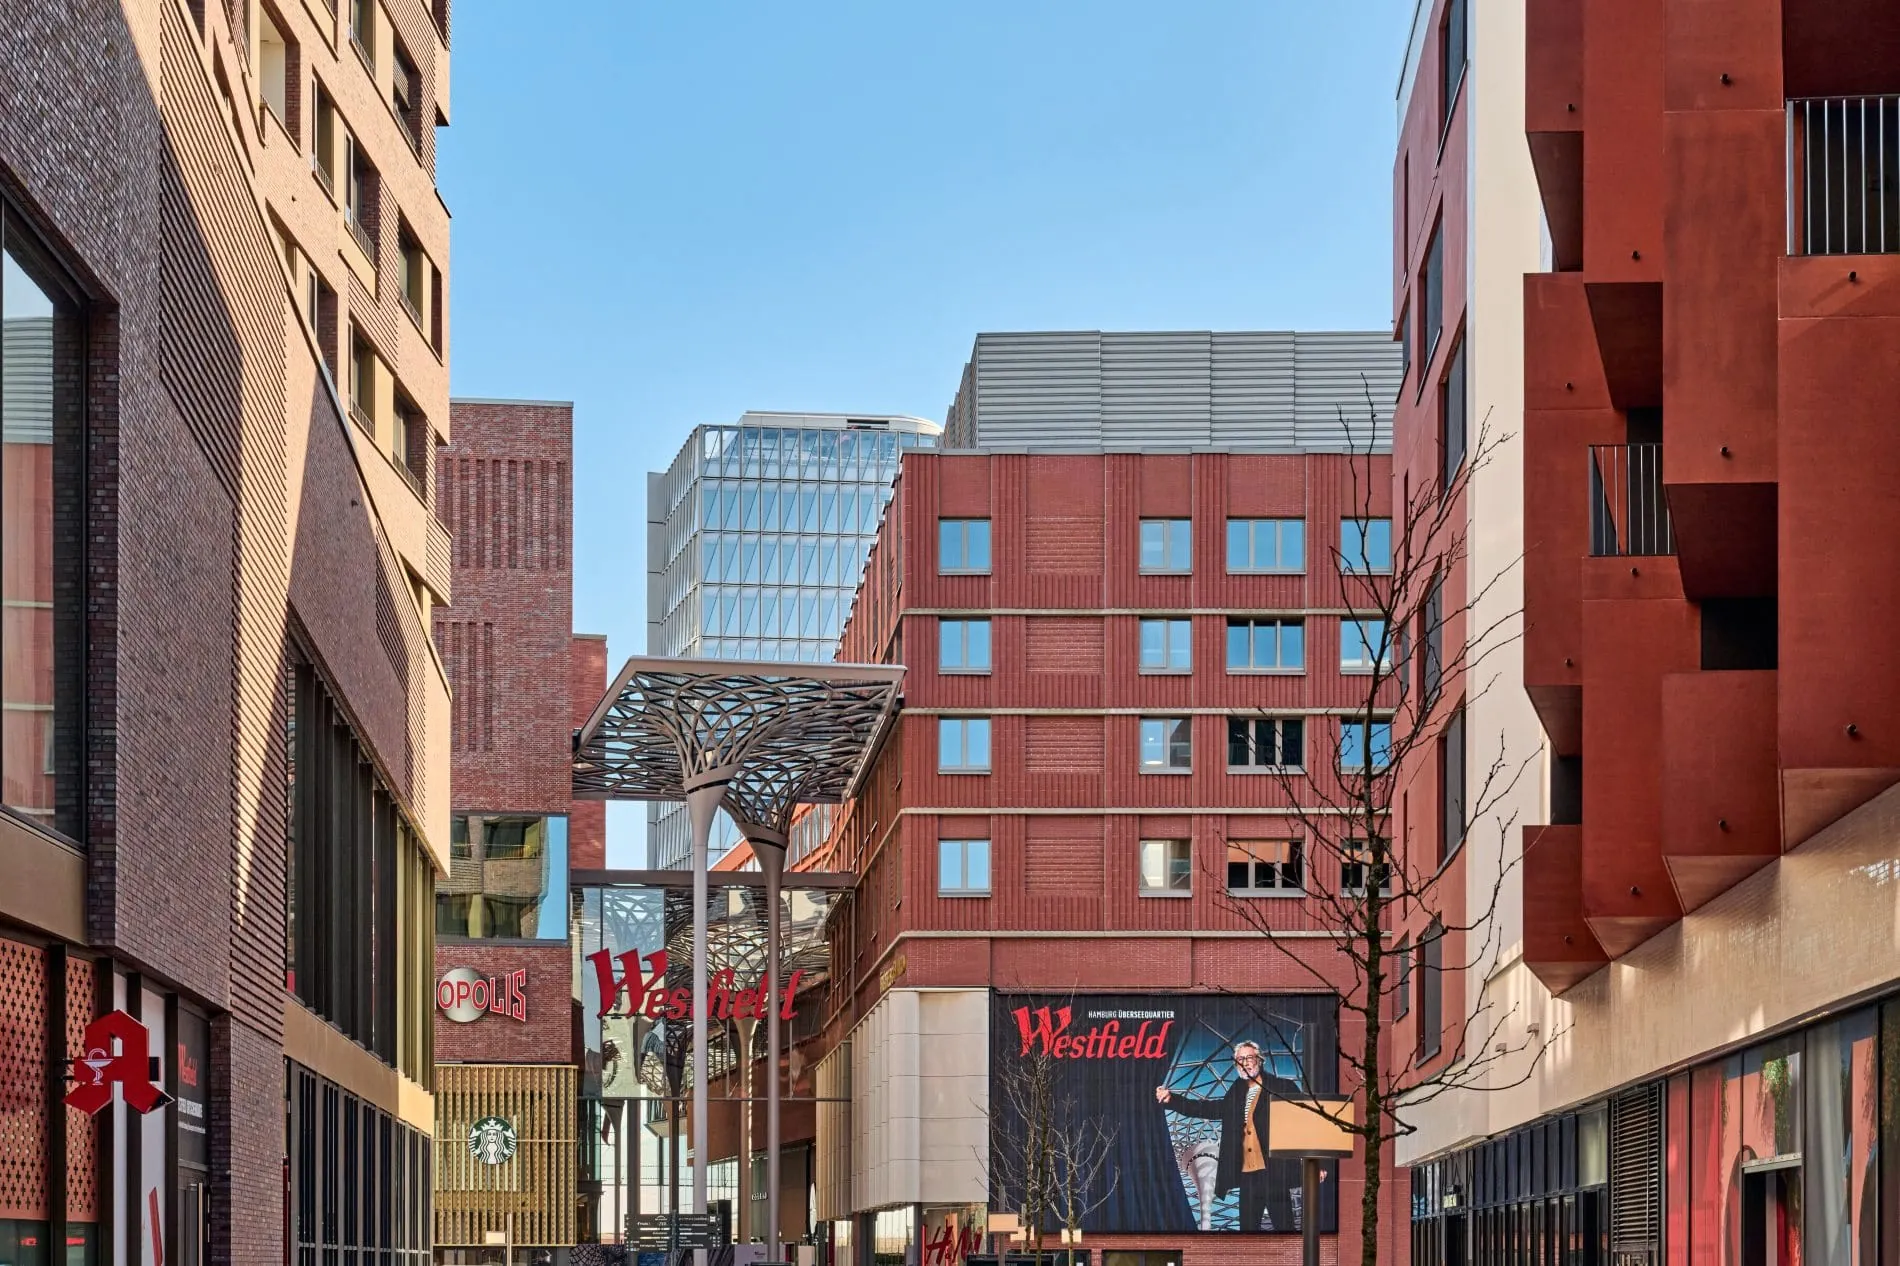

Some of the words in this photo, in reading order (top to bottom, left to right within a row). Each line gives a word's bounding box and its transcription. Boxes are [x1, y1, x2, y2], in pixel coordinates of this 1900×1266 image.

[434, 967, 526, 1023] OPOLIS
[585, 948, 806, 1020] Wesfield
[1011, 1006, 1175, 1059] Westfield
[1088, 1010, 1117, 1019] HAMBURG
[1118, 1009, 1175, 1019] ÜBERSEEQUARTIER
